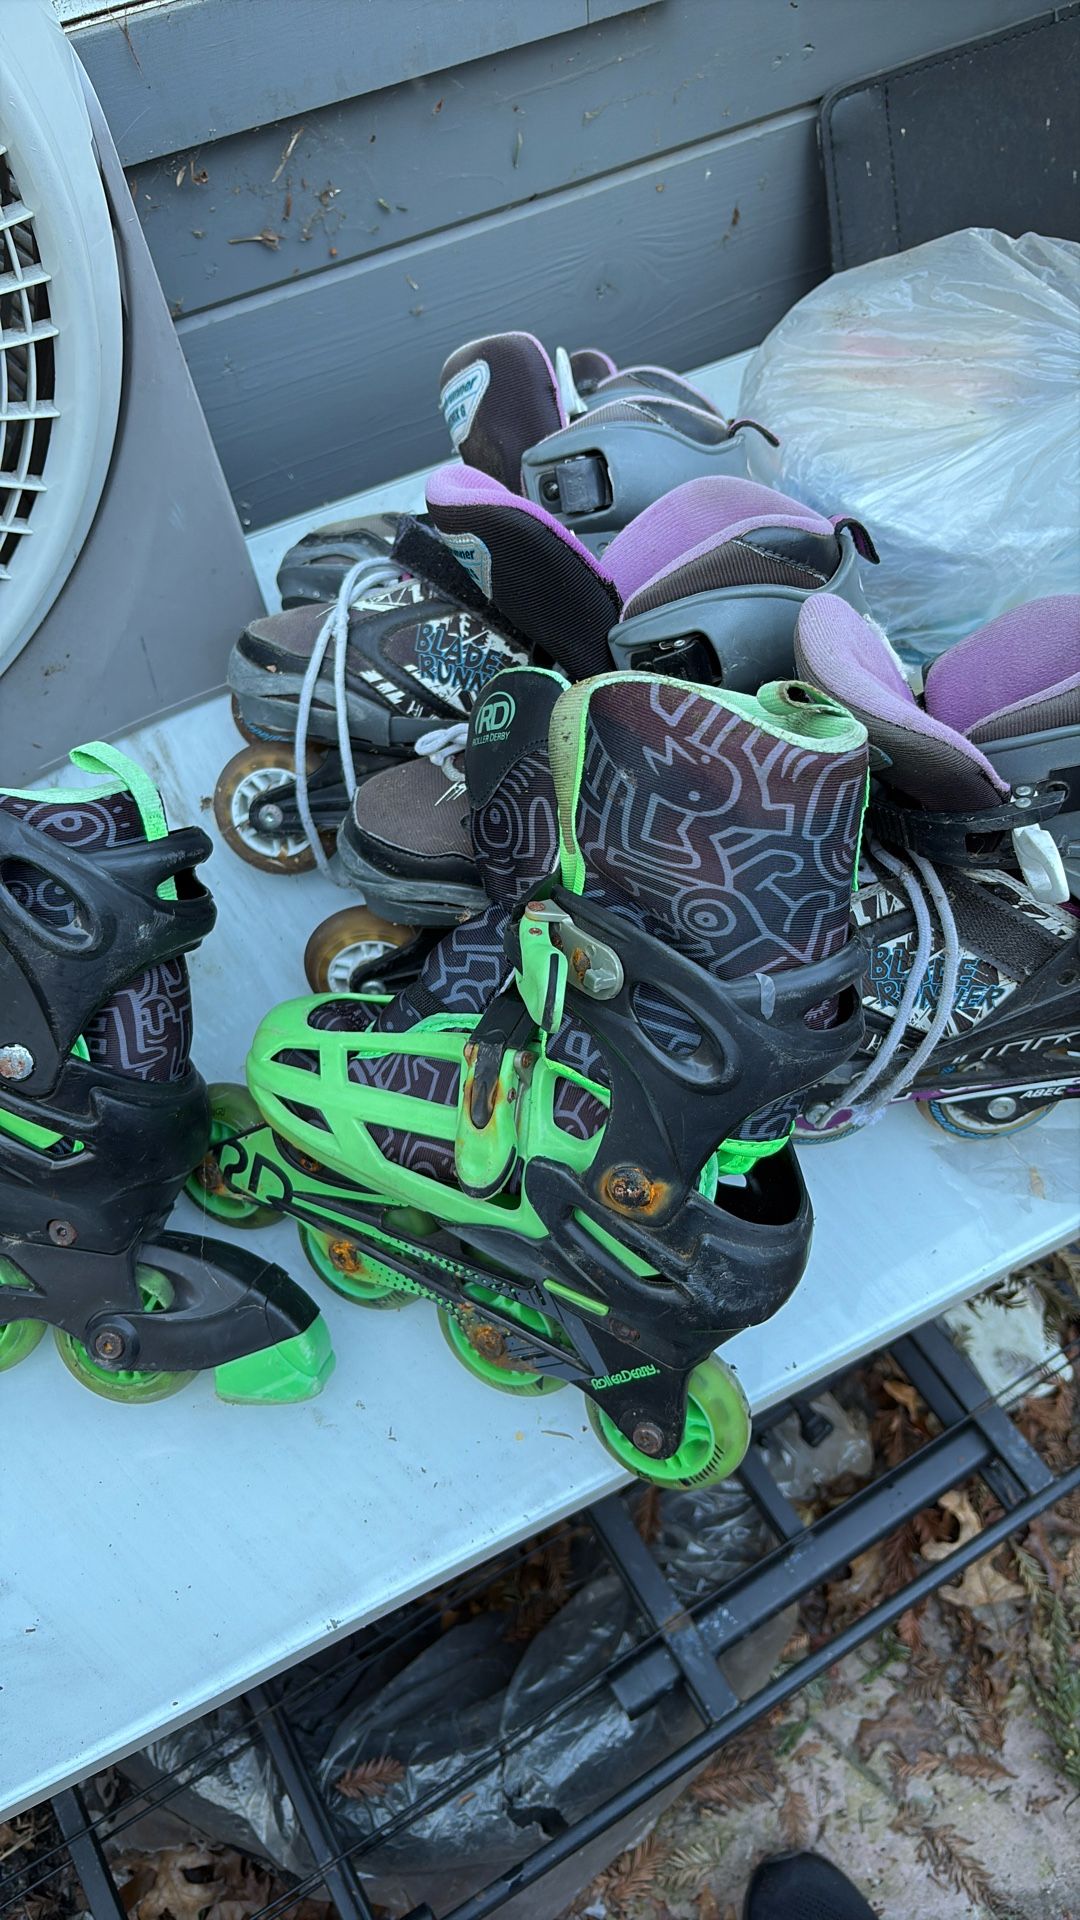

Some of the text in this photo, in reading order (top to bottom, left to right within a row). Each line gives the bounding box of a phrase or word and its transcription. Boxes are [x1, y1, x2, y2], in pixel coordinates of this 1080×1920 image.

[414, 621, 505, 677] BLADE
[477, 700, 510, 735] RD
[472, 730, 511, 747] ROLLER DERBY
[1020, 1086, 1066, 1099] ABEC
